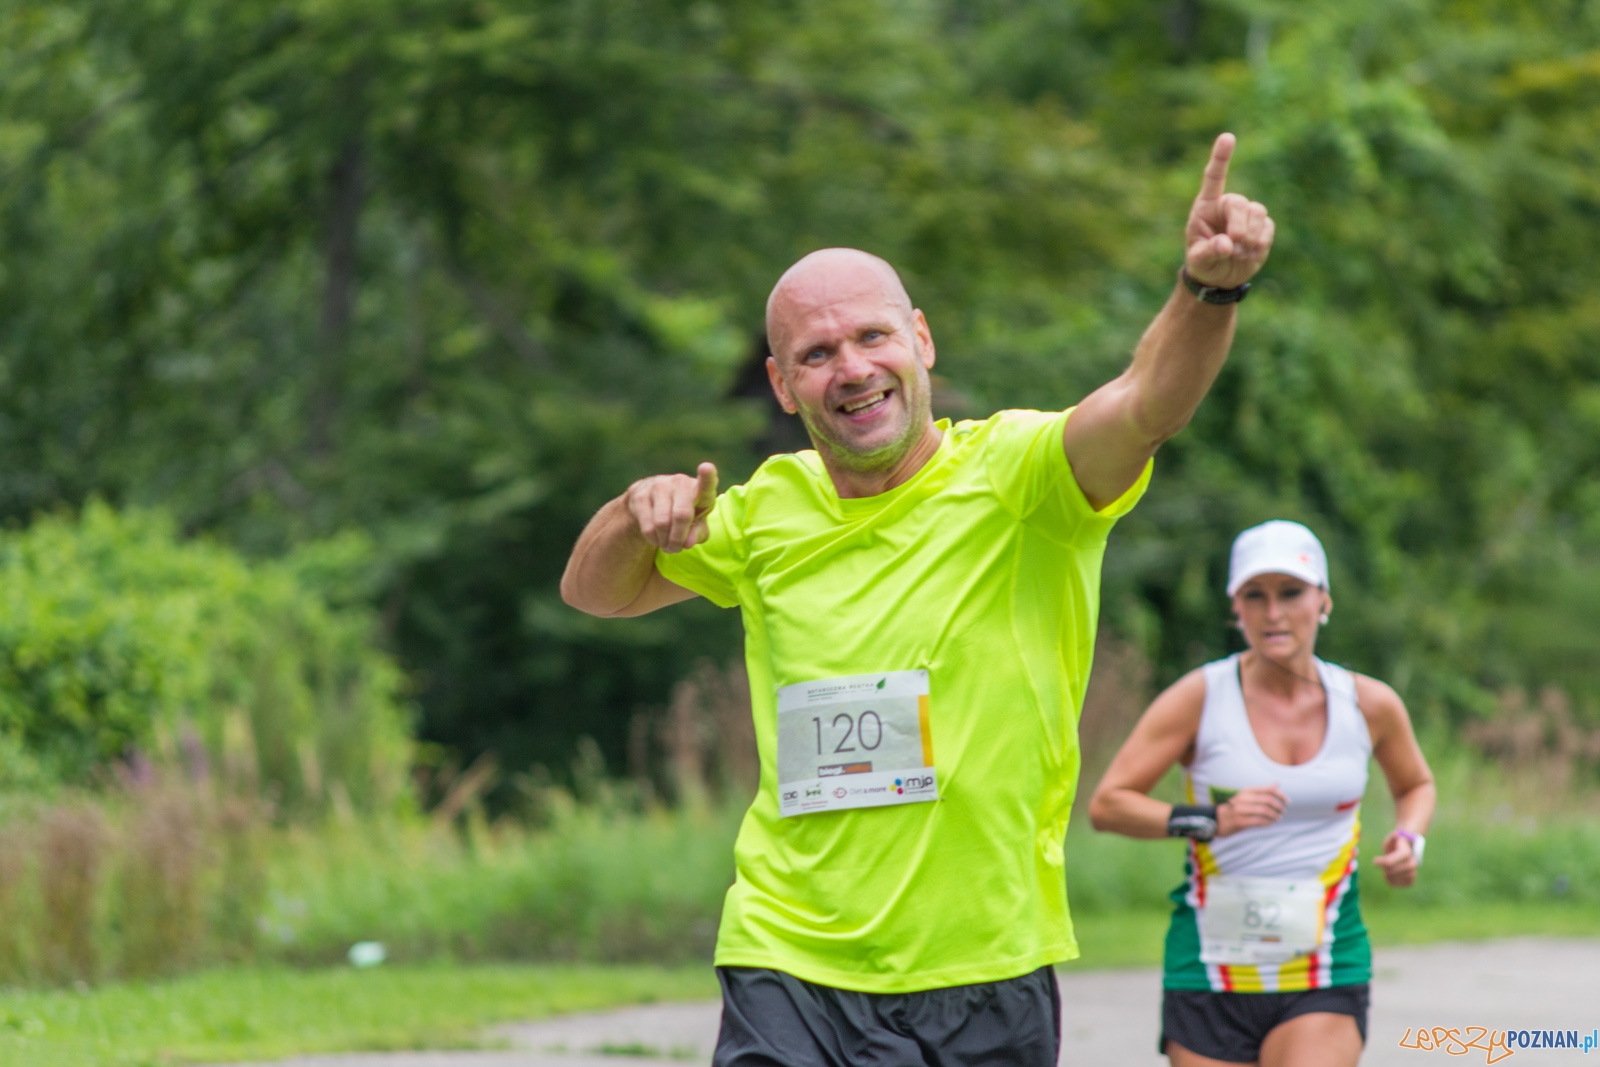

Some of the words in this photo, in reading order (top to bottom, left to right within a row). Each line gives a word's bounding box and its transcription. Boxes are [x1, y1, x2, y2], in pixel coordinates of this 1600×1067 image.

[812, 710, 882, 755] 120
[906, 775, 934, 789] mjp
[1244, 901, 1280, 929] 82
